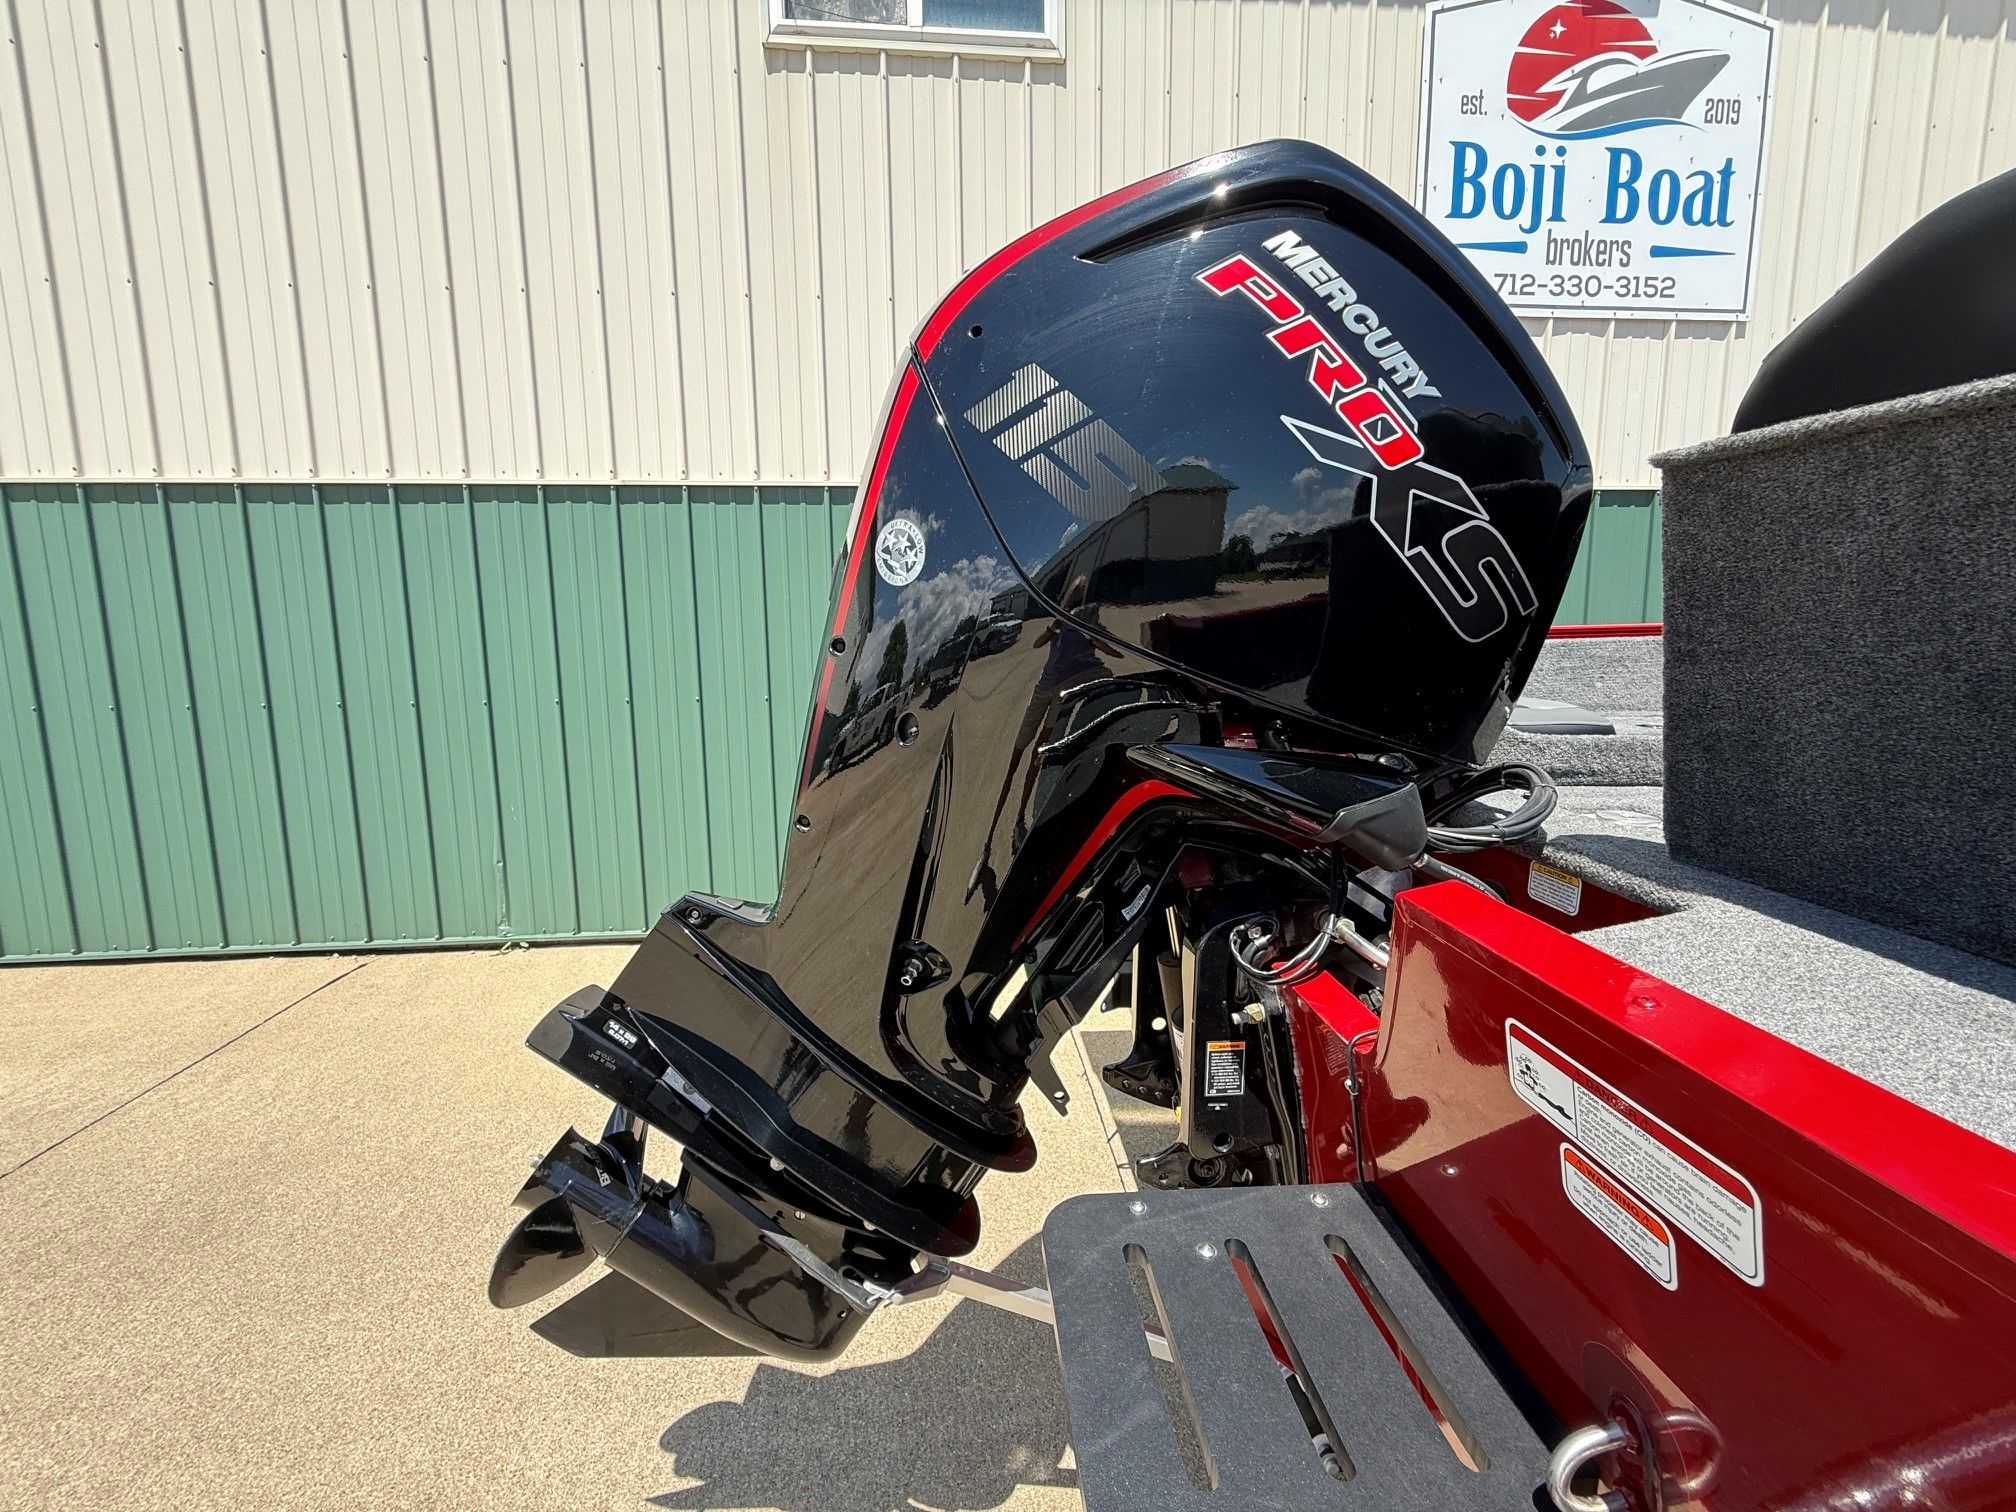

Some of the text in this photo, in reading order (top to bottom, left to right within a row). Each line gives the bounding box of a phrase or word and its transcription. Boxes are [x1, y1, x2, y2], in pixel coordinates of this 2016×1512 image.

[1460, 89, 1487, 116] est.
[1704, 97, 1742, 126] 2019
[1444, 141, 1736, 234] Boji Boat
[1545, 229, 1632, 268] brokers
[1494, 273, 1677, 299] 712-330-3152
[1261, 230, 1442, 400] MERCURY
[1196, 253, 1539, 643] PRO XS
[1577, 1085, 1599, 1106] Carbon
[1600, 1103, 1632, 1130] monoxide
[1634, 1126, 1650, 1145] (CO)
[1585, 1078, 1636, 1121] DANGER
[1586, 1166, 1639, 1219] WARNING
